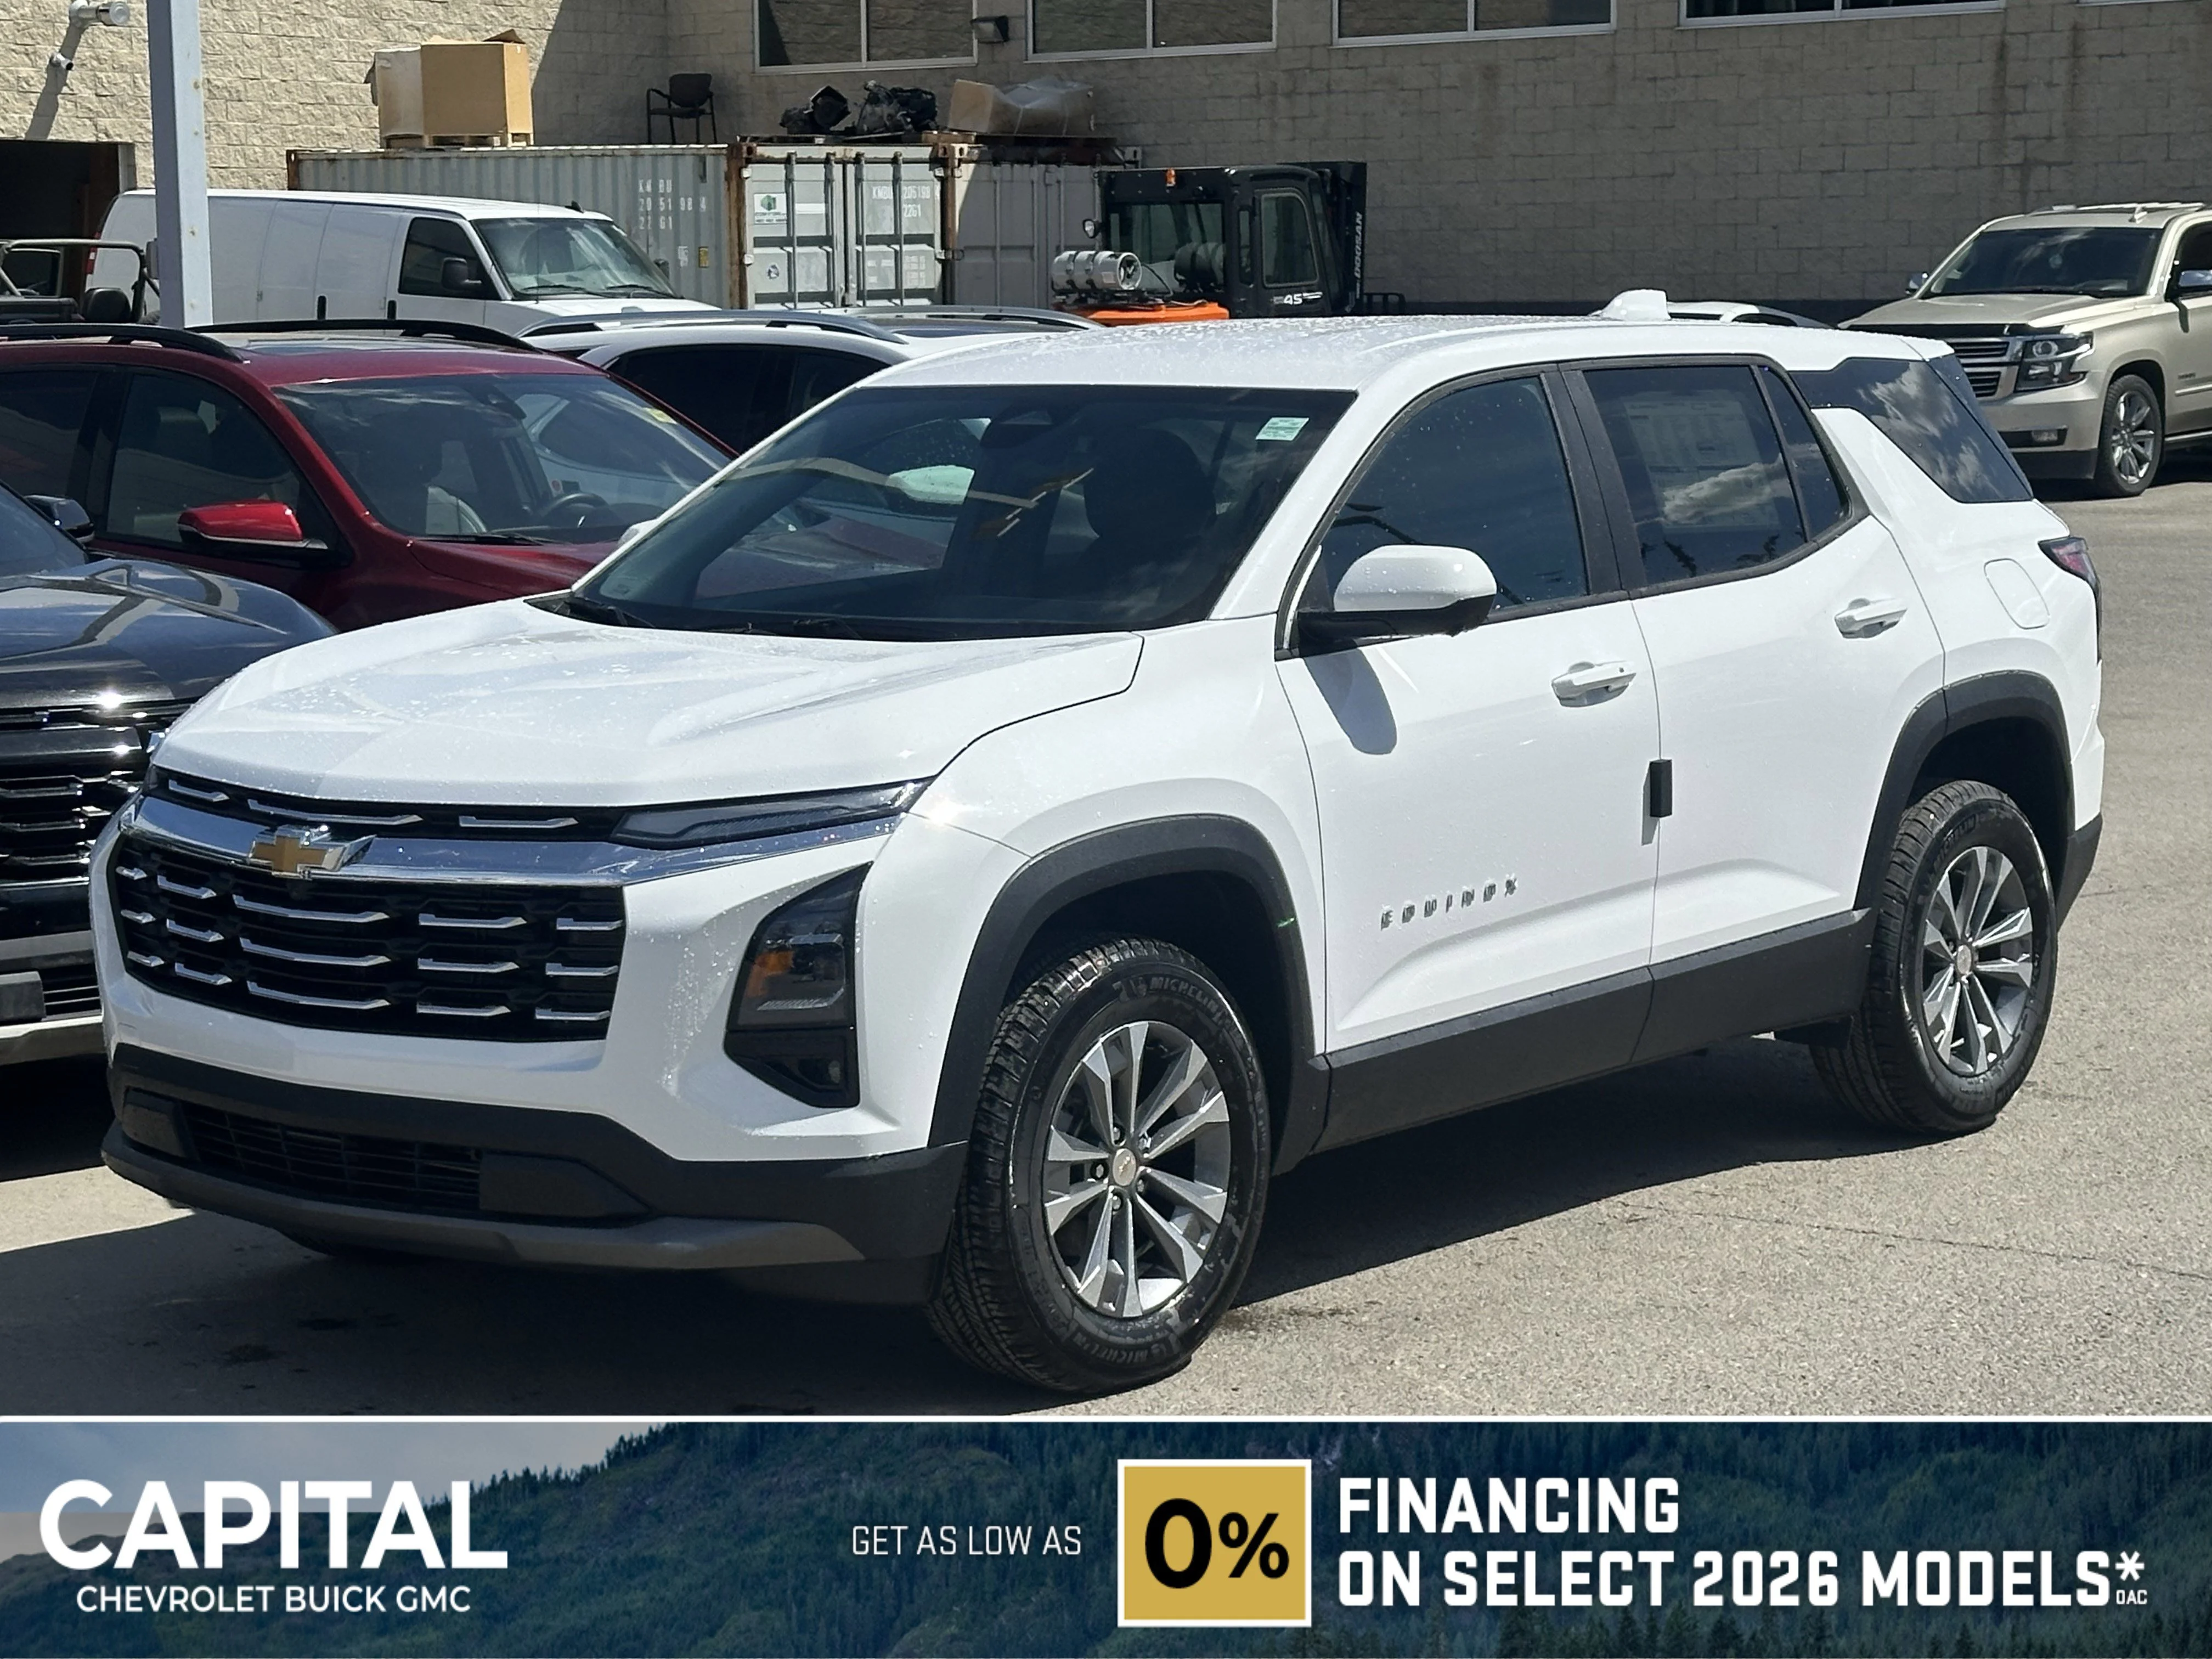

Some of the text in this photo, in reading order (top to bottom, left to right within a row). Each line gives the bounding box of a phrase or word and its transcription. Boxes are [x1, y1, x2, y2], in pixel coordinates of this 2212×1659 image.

[902, 185, 931, 199] 205198
[1354, 211, 1363, 279] DOOSAN
[1284, 294, 1303, 305] 45
[1380, 874, 1517, 931] EQUINOX
[1149, 977, 1221, 1012] MICHELIN
